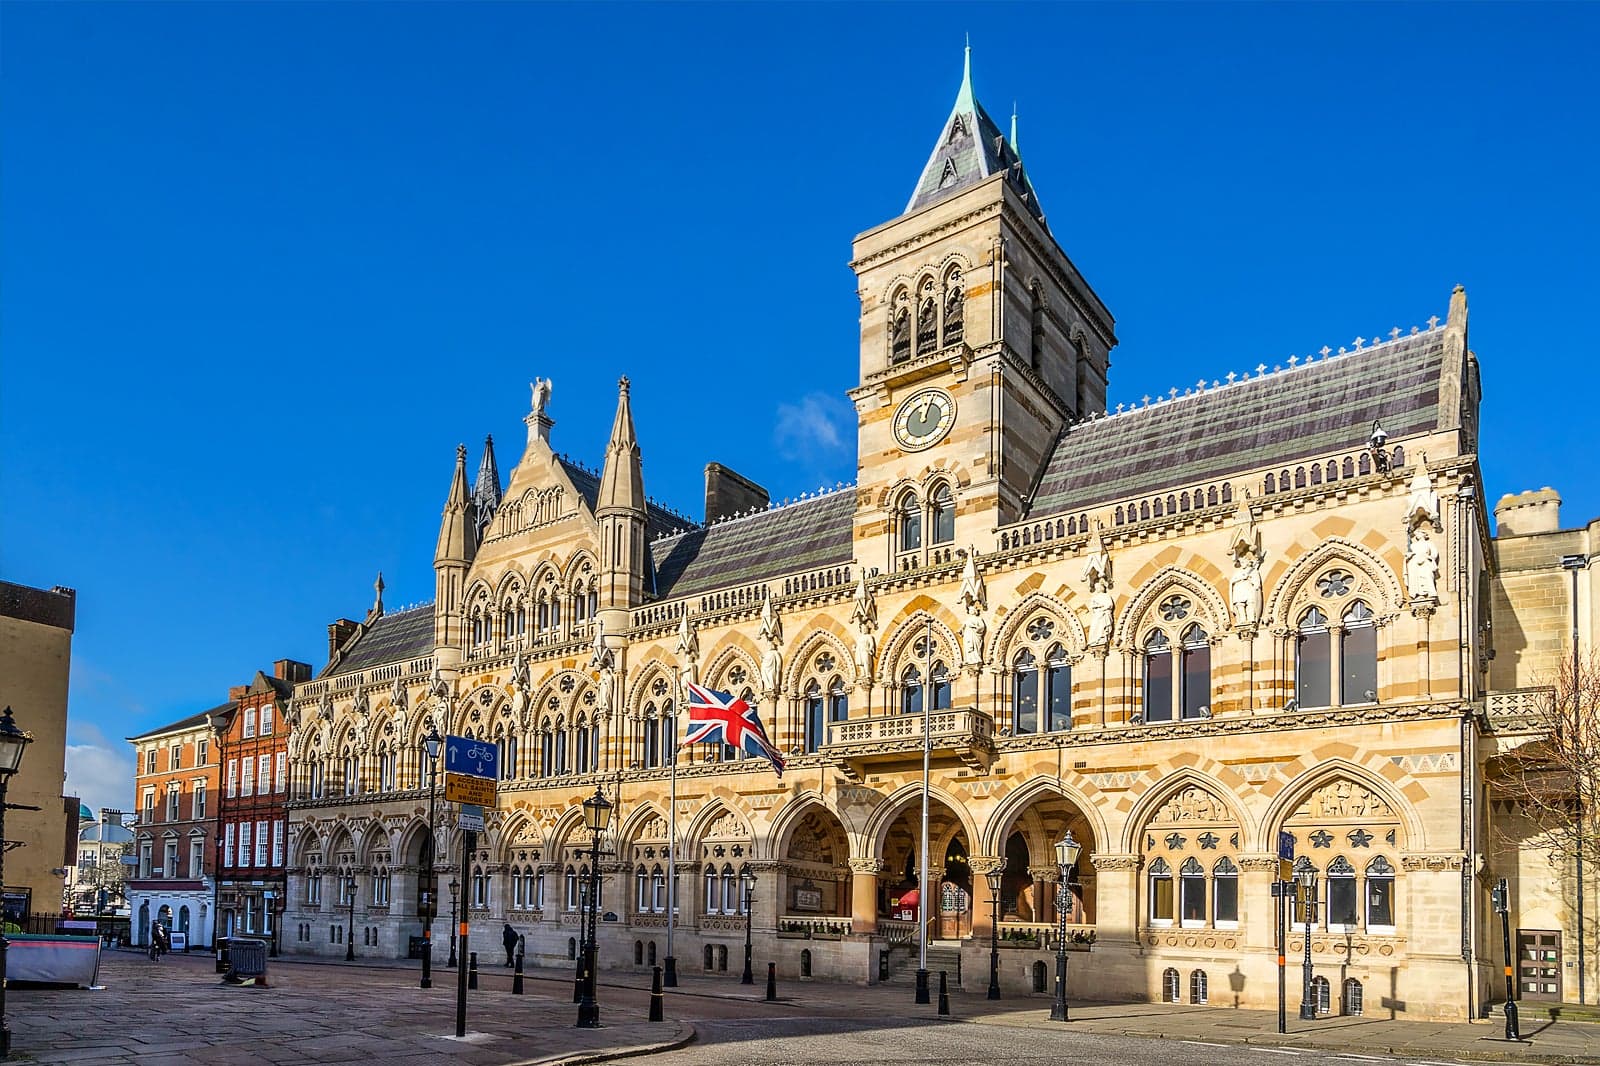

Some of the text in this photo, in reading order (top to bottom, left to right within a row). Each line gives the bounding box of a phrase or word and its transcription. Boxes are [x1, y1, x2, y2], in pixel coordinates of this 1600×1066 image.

[457, 777, 484, 786] ACCESS
[470, 784, 494, 793] SAINTS
[458, 794, 482, 802] BRIDGE
